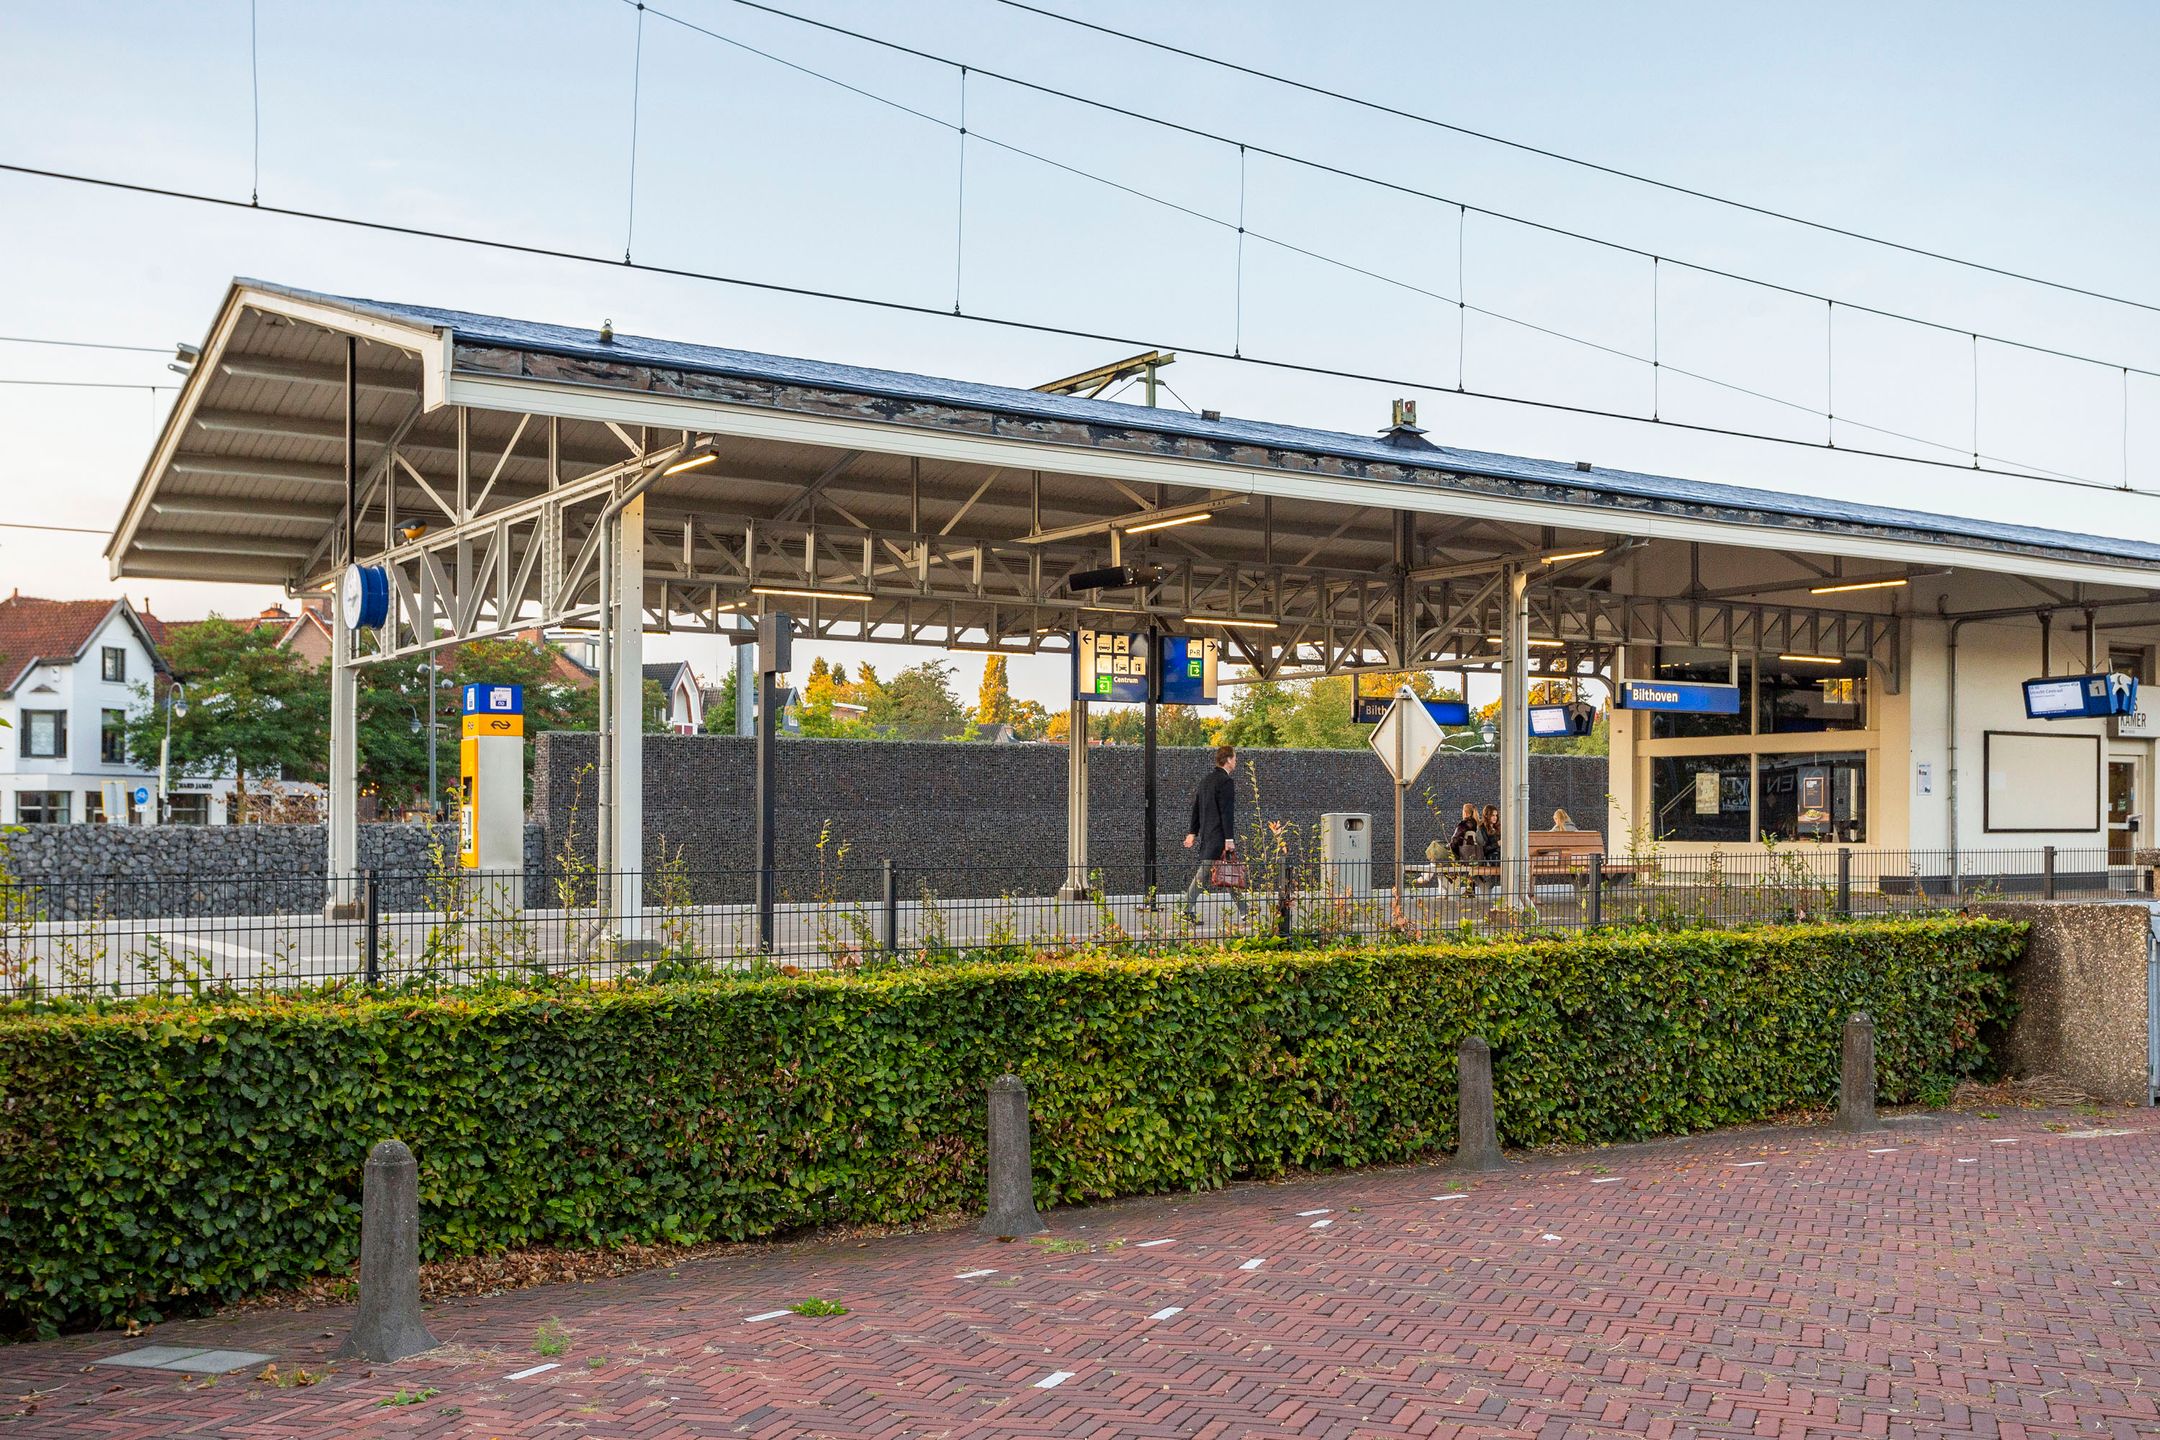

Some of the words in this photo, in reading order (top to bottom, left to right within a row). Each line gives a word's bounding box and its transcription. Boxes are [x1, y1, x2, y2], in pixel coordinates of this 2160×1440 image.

[1114, 676, 1138, 684] Centrum
[1633, 689, 1678, 702] Bilthoven
[2095, 686, 2100, 695] 1
[1366, 705, 1387, 715] Bilth
[2120, 712, 2146, 727] KAMER
